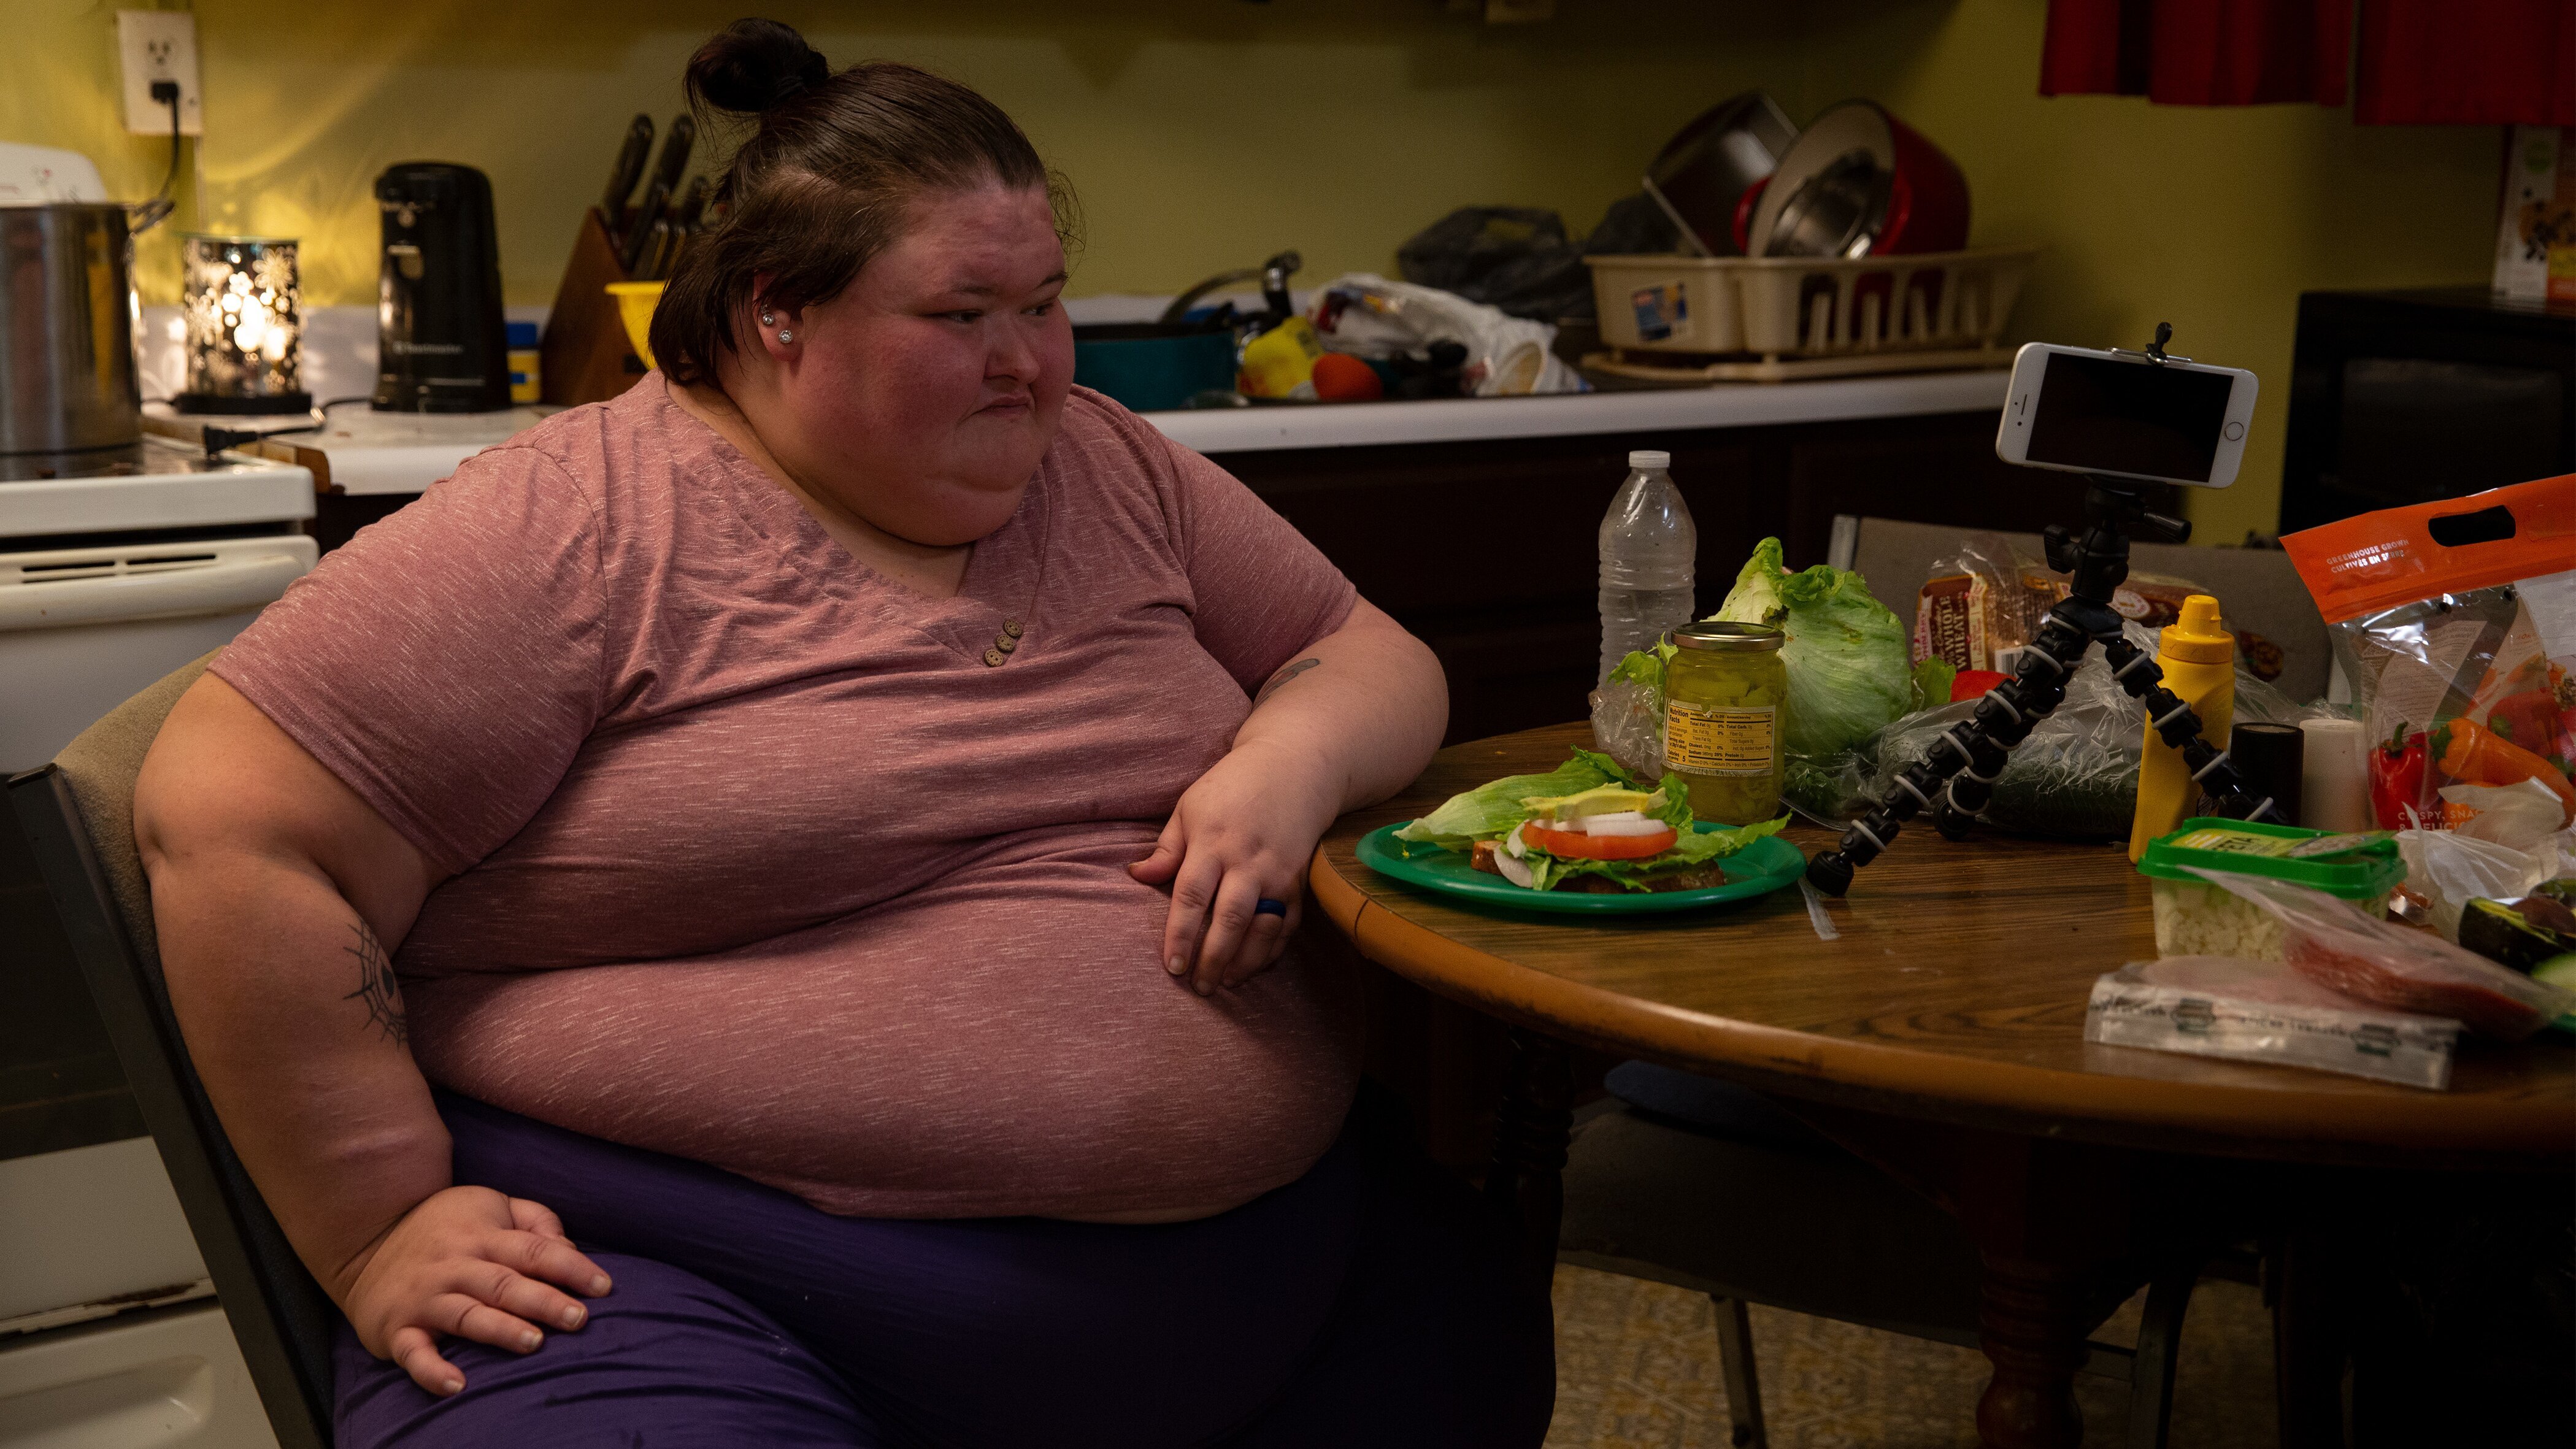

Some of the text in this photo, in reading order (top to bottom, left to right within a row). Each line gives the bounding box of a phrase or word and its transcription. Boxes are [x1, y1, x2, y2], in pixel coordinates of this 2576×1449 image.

[2326, 539, 2409, 564] GREENHOUSE GROWN
[2369, 555, 2381, 564] EN
[1939, 595, 1955, 652] WHOLE
[1953, 613, 1967, 669] WHEAT
[1670, 707, 1688, 717] Nutrition
[1669, 715, 1680, 723] Facts
[2397, 810, 2445, 821] CSPY,
